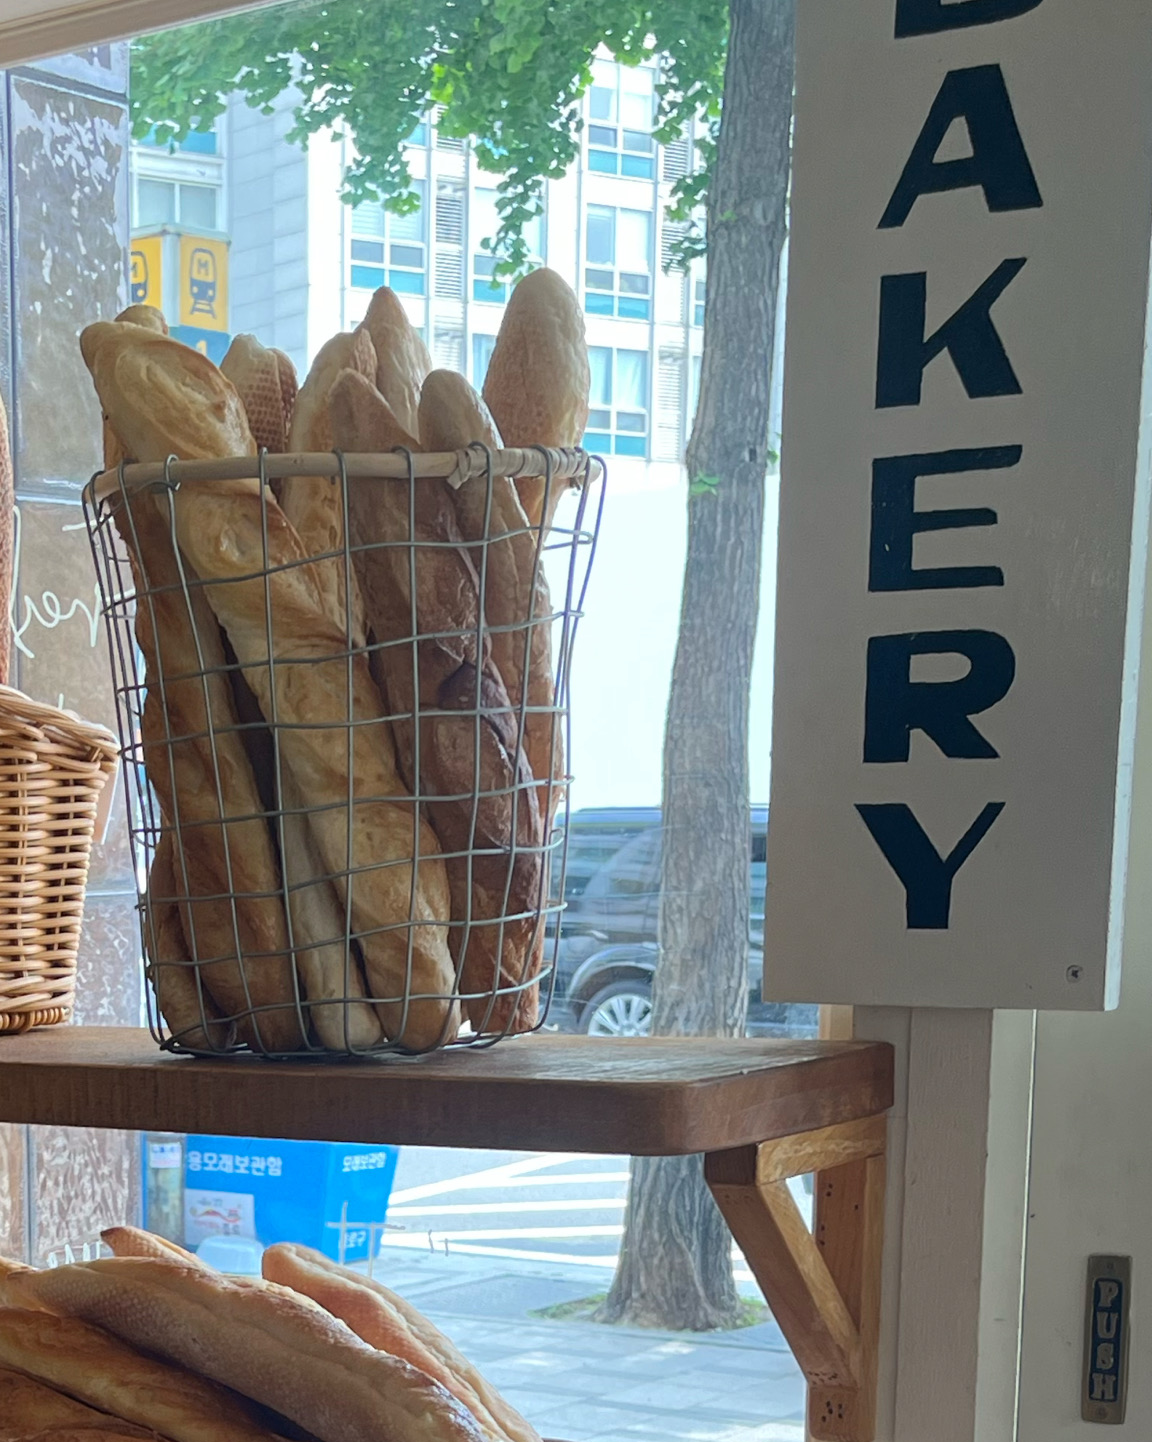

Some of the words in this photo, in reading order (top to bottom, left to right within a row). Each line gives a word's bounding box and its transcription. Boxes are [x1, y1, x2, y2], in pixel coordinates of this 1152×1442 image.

[854, 0, 1044, 931] AKERY
[342, 1152, 387, 1173] 모래보관함
[1090, 1279, 1119, 1400] PUSH
